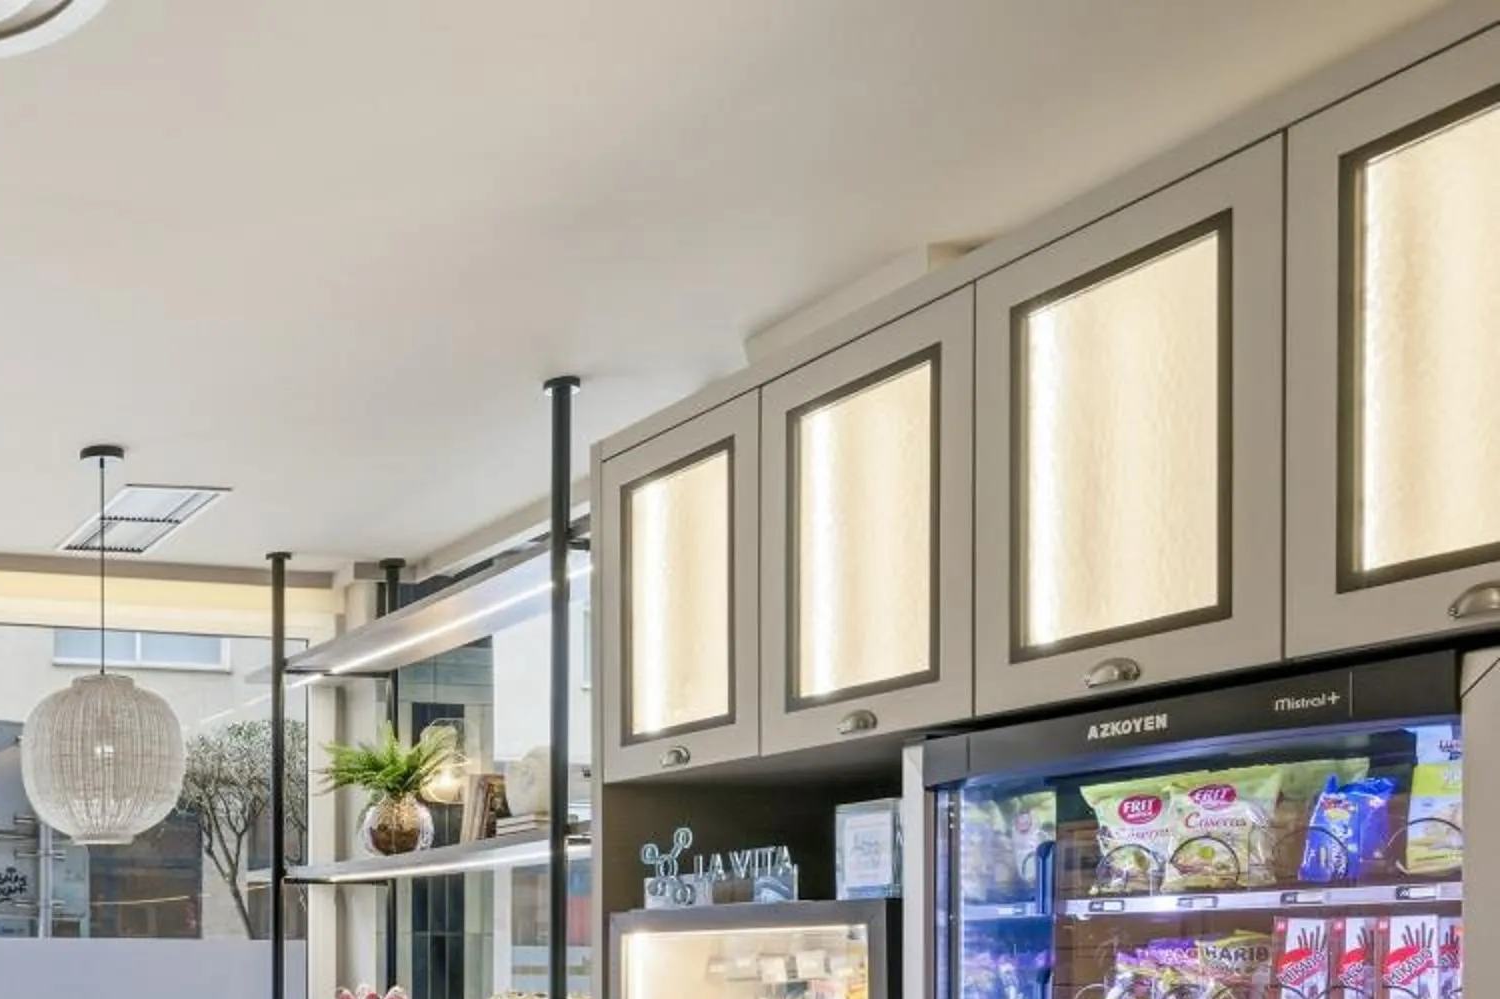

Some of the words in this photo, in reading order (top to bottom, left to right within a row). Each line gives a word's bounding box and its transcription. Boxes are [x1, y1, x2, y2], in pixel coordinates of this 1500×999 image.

[1087, 713, 1169, 740] AZKOYEN
[729, 845, 793, 880] VITA
[1205, 945, 1269, 962] HARIB
[1384, 947, 1433, 986] MIKADO
